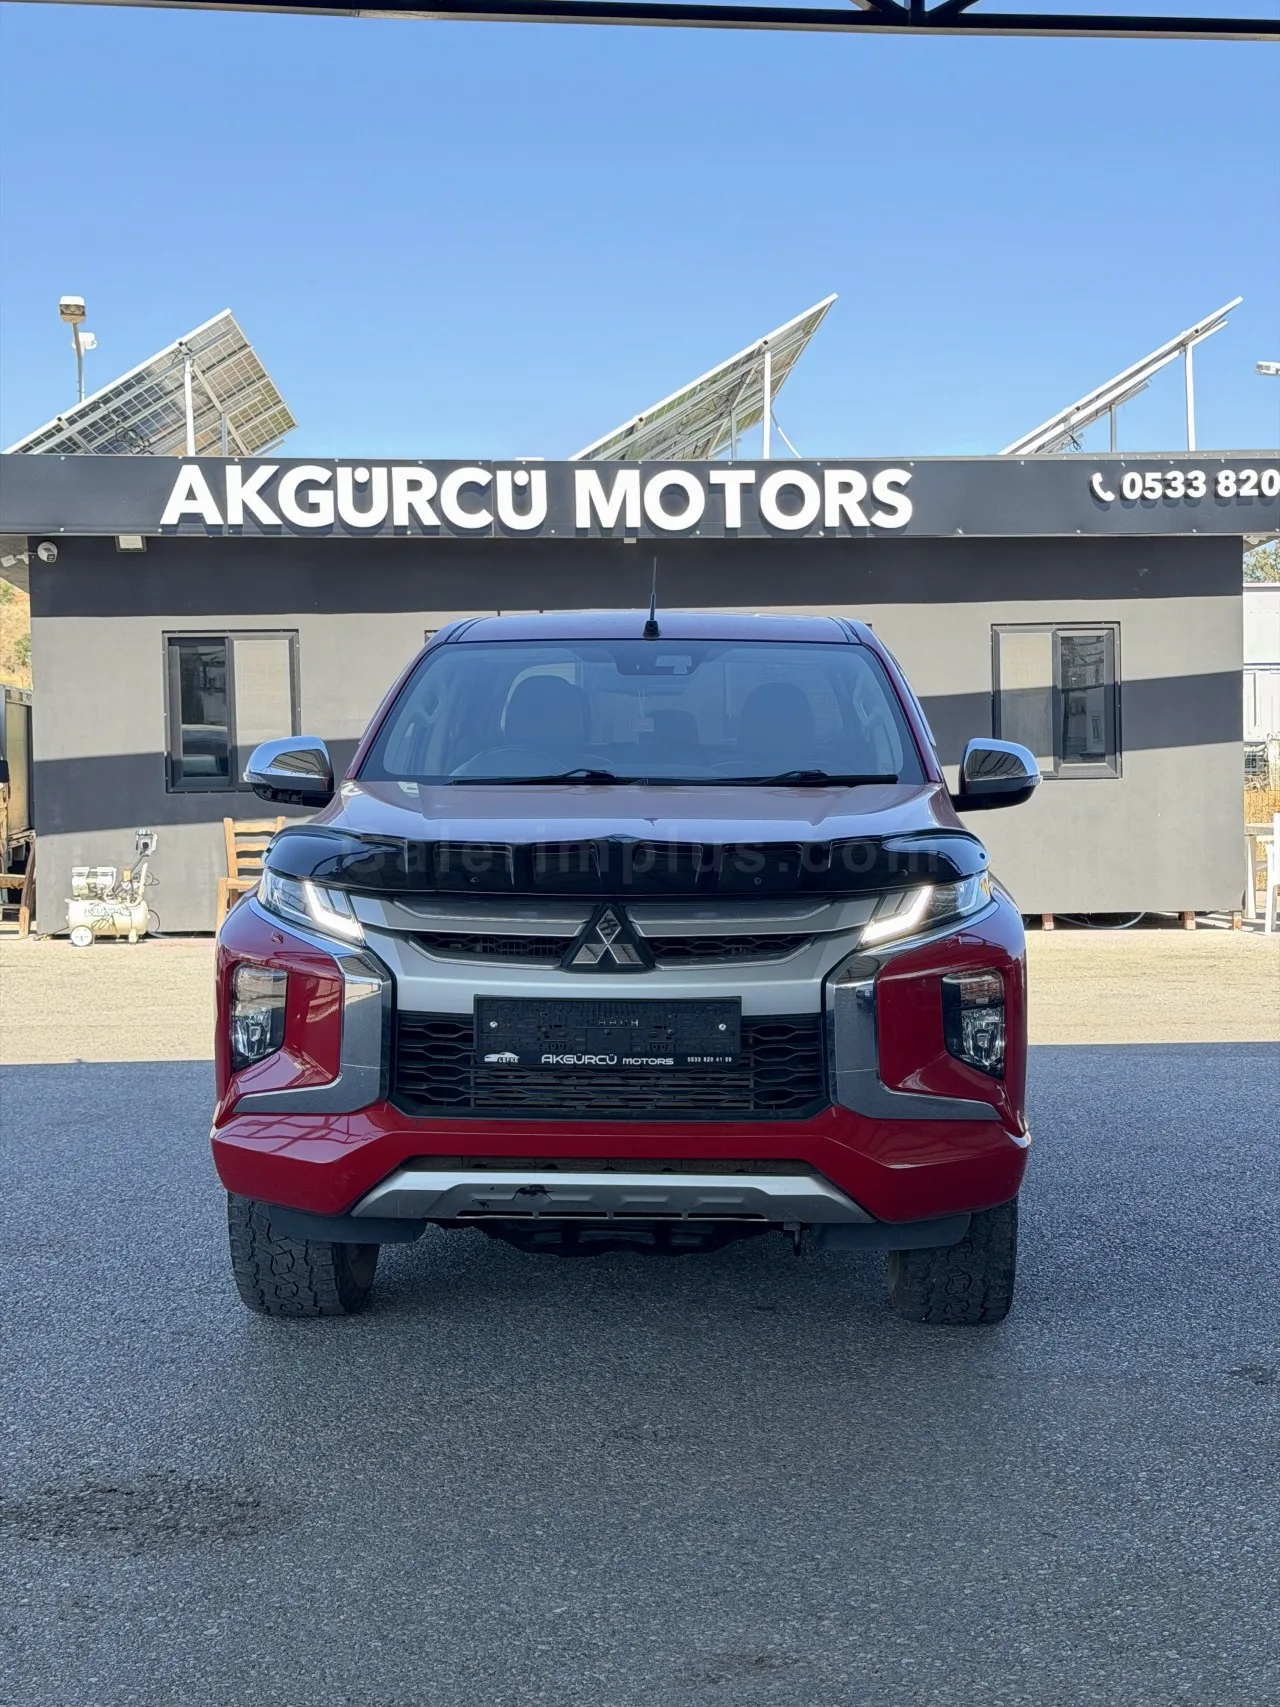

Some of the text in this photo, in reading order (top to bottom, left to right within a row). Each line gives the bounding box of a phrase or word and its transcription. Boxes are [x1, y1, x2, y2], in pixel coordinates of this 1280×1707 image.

[160, 464, 914, 531] AKGÜRCÜ MOTORS
[1121, 468, 1280, 500] 0533 820
[541, 1053, 674, 1065] AKGÜRCÜ MOTORS
